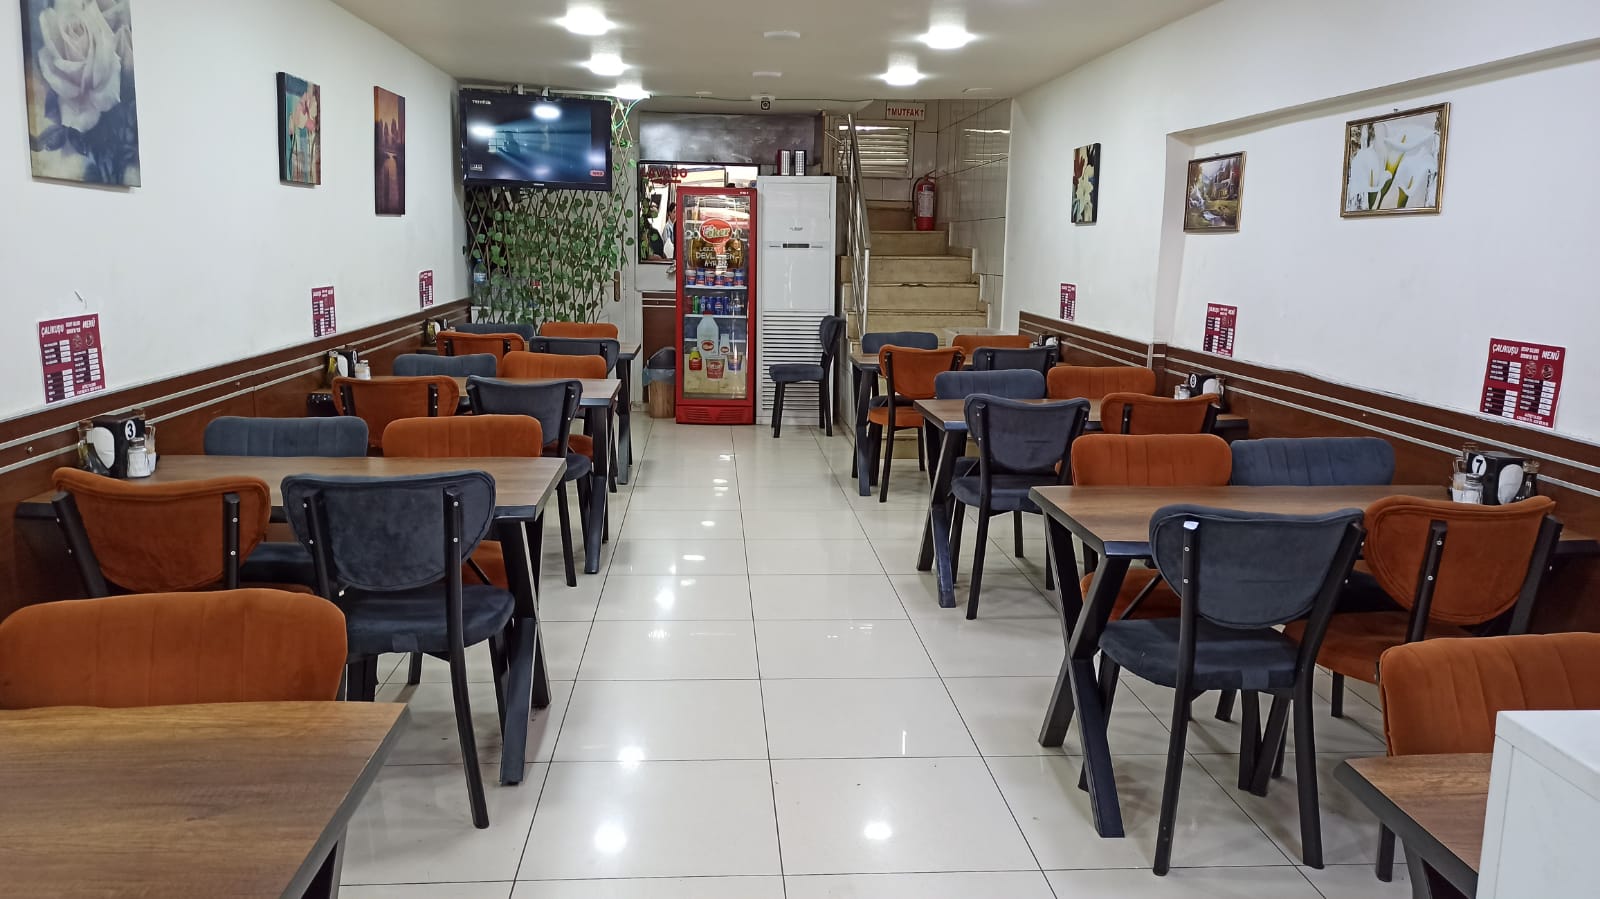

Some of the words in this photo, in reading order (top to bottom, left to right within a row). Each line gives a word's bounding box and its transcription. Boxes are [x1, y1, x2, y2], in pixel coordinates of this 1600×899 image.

[891, 107, 920, 117] MUTFAK
[640, 167, 688, 178] LAVABO
[82, 317, 96, 329] MENÜ
[1542, 350, 1561, 361] MENÜ
[127, 423, 135, 438] 3
[1475, 458, 1484, 474] 7
